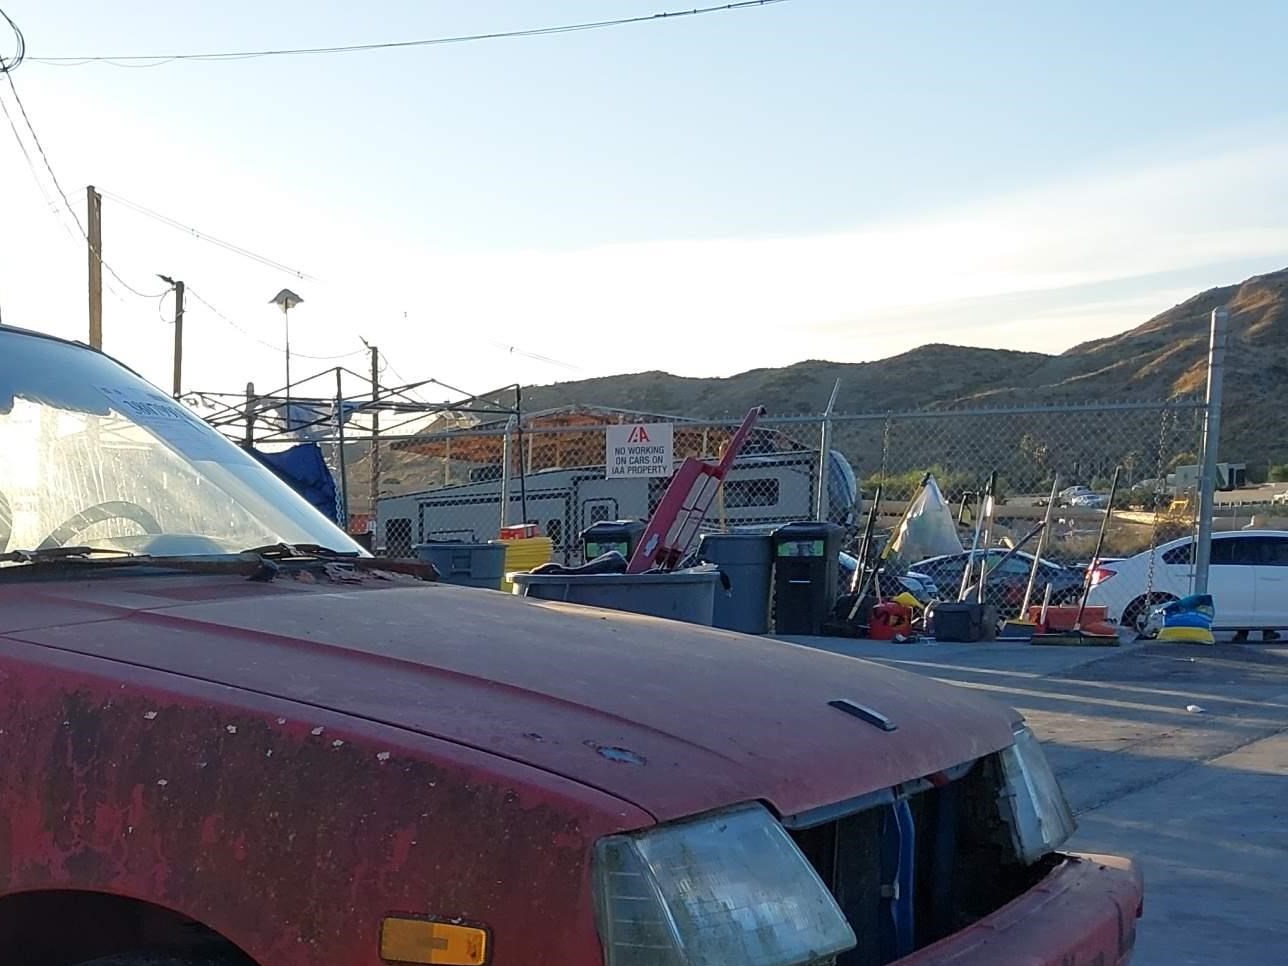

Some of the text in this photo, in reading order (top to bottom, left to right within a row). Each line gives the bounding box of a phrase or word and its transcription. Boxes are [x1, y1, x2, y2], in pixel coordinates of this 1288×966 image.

[614, 446, 665, 456] NO WORKING
[615, 455, 664, 465] ON CARS ON
[611, 465, 668, 474] IAA PROPERTY
